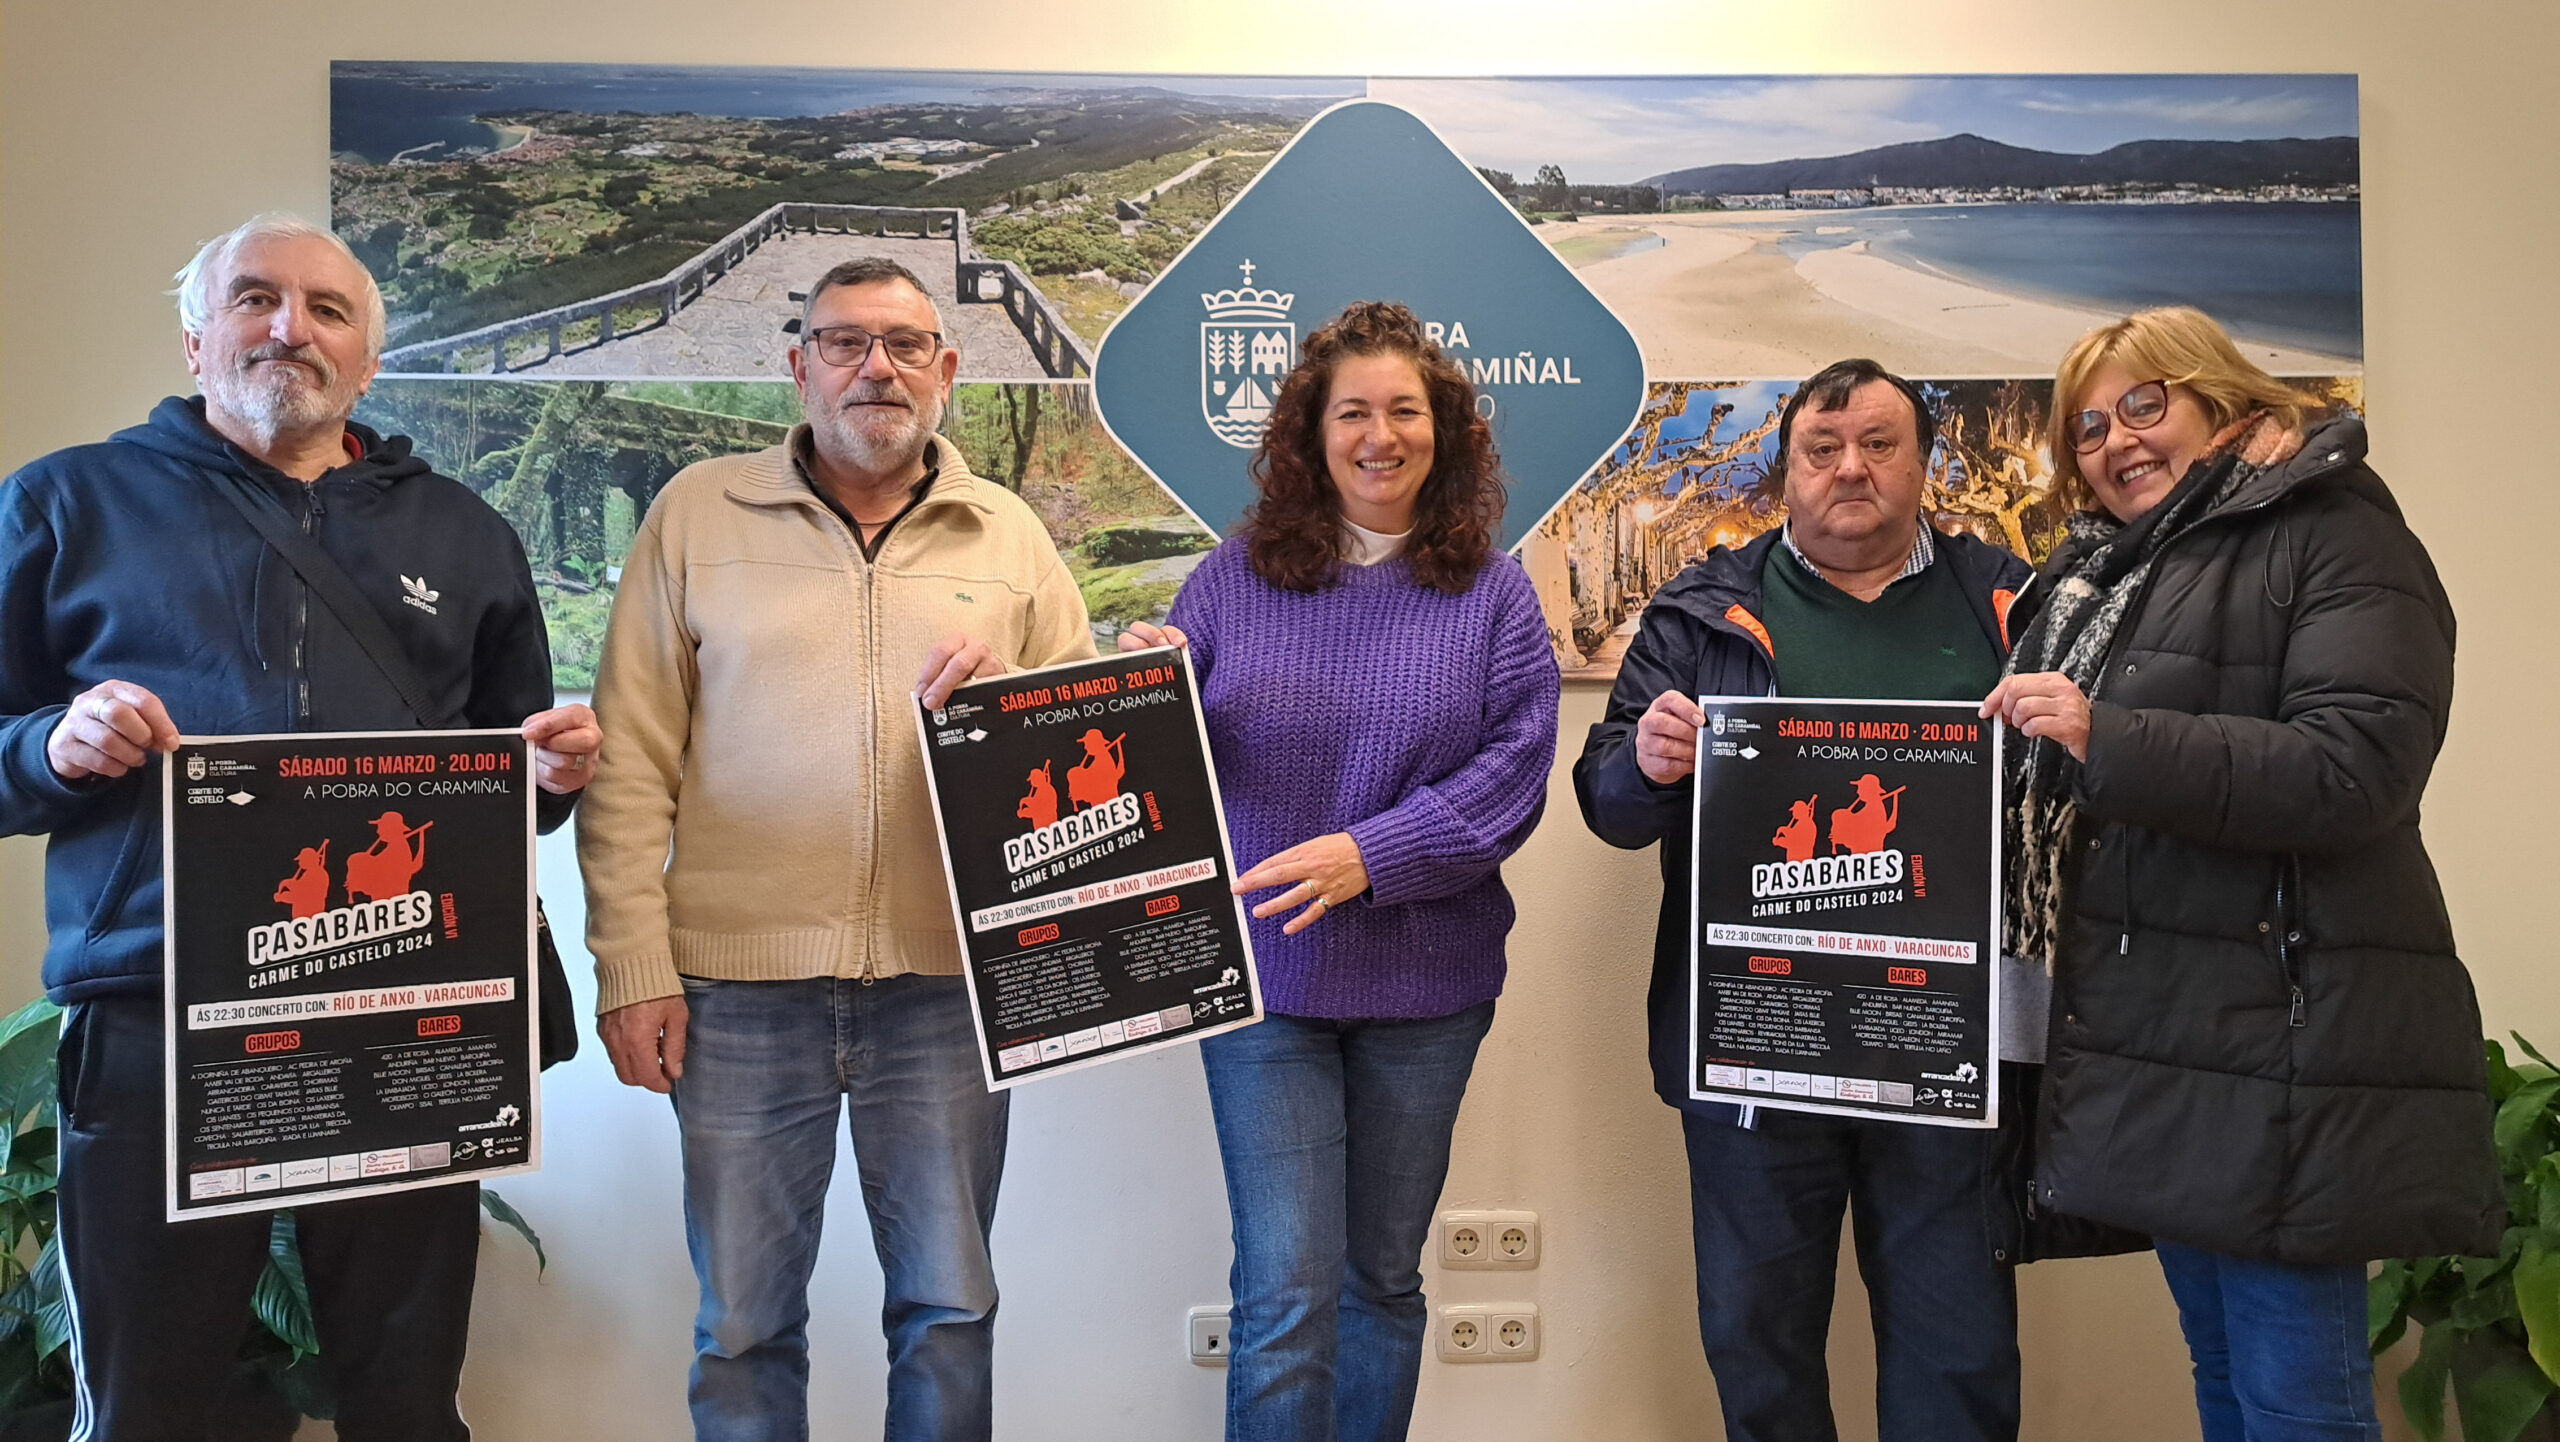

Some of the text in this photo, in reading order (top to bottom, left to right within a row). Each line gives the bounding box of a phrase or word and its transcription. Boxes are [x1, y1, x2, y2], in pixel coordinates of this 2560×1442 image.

[403, 595, 437, 615] adidas
[1000, 665, 1174, 712] SÁBADO 16 MARZO 20.00 H
[1024, 689, 1179, 728] A POBRA DO CARAMIÑAL
[1778, 717, 1977, 741] SÁBADO 16 MARZO 20.00 H
[279, 753, 510, 777] SÁBADO 16 MARZO 20.00 H
[1797, 745, 1977, 764] A POBRA DO CARAMIÑAL
[304, 777, 510, 799] A POBRA DO CARAMIÑAL
[1143, 791, 1163, 831] EDICIÓN VI
[1008, 797, 1135, 867] PASABARES
[1011, 827, 1145, 893] CARME DO CASTELO 2024
[1757, 854, 1897, 892] PASABARES
[1911, 854, 1926, 897] EDICIÓN VI
[979, 863, 1210, 925] ÁS 22:30 CONCERTO CON: RÍO DE ANXO VARACUNCAS
[1147, 895, 1178, 914] BARES
[1752, 889, 1903, 917] CARME DO CASTELO 2024
[254, 896, 425, 959] PASABARES
[440, 893, 458, 939] EDICIÓN VI
[1020, 925, 1057, 944] GRUPOS
[1713, 928, 1969, 959] ÁS 22:30 CONCERTO CON: RÍO DE ANXO VARACUNCAS
[249, 933, 432, 989] CARME DO CASTELO 2024
[1750, 957, 1789, 973] GRUPOS
[1890, 968, 1925, 983] BARES
[197, 983, 507, 1022] ÁS 22:30 CONCERTO CON: RÍO DE ANXO VARACUNCAS
[420, 1016, 459, 1033] BARES
[247, 1033, 298, 1051] GRUPOS
